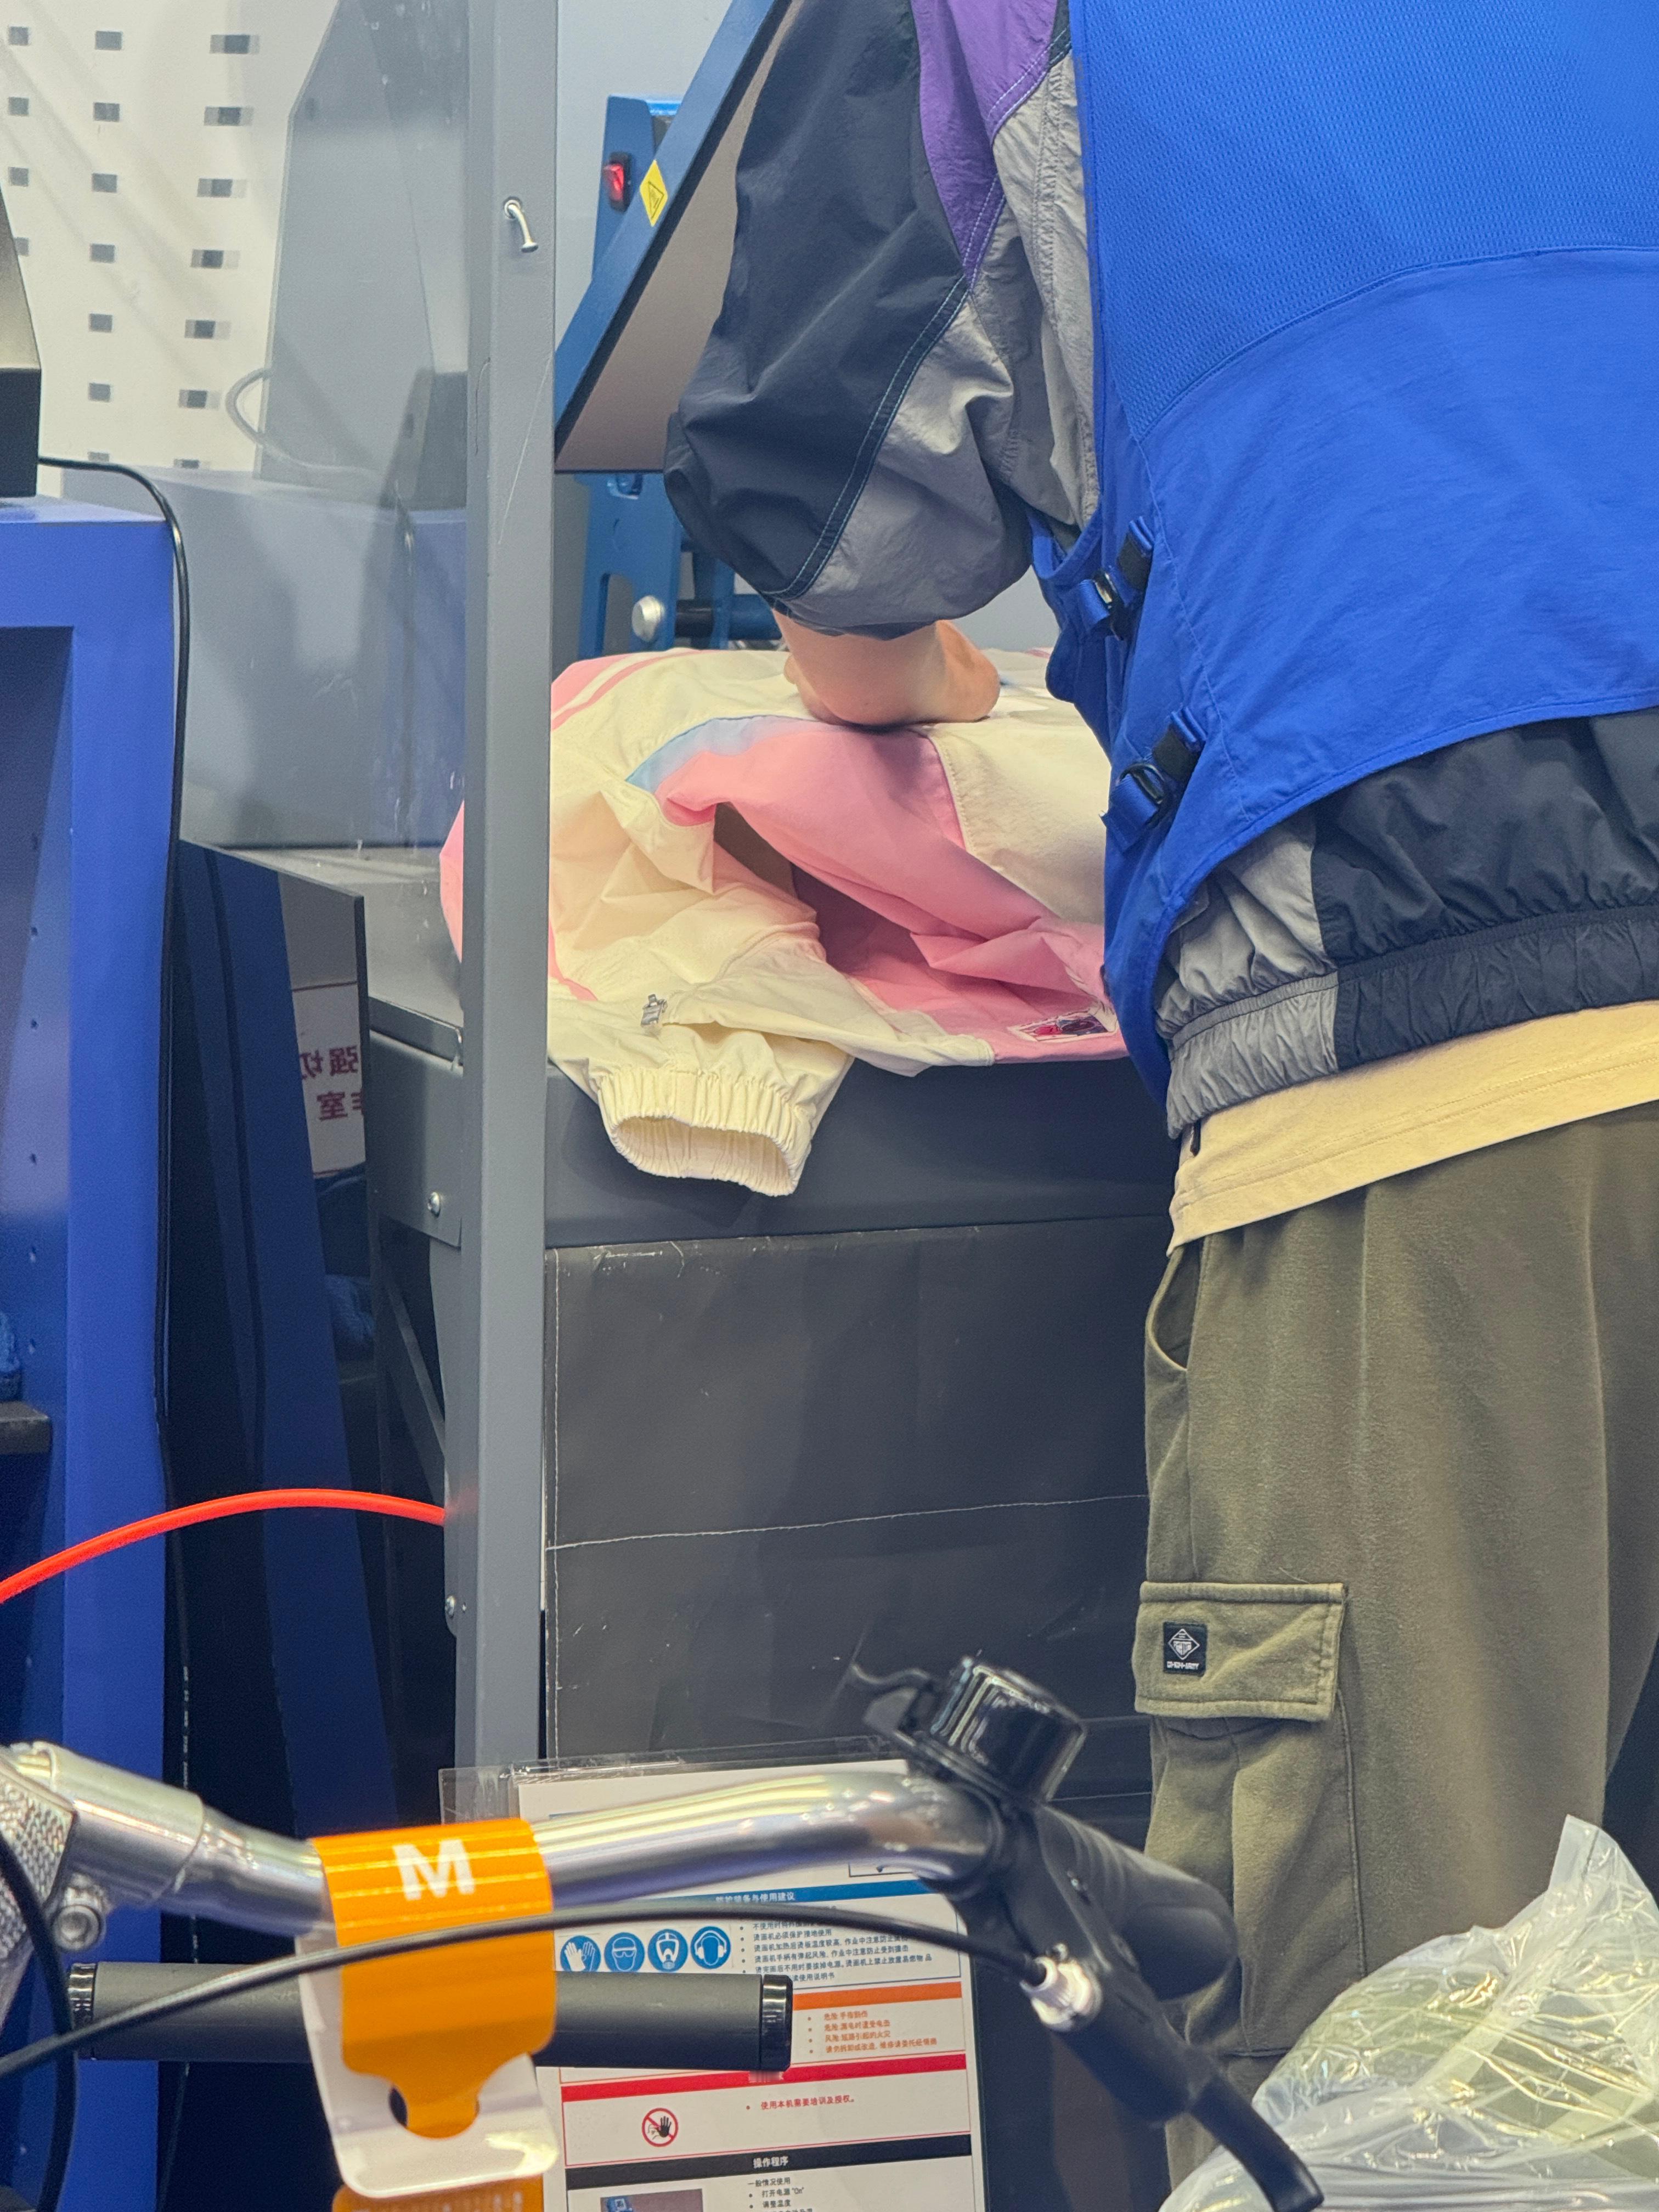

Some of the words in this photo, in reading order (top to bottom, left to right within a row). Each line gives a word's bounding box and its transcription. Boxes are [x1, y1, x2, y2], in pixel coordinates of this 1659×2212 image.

[392, 1838, 476, 1901] M
[753, 2156, 788, 2169] 操作程序
[748, 2177, 790, 2187] 一般情况使用
[763, 2199, 791, 2208] 调整温度
